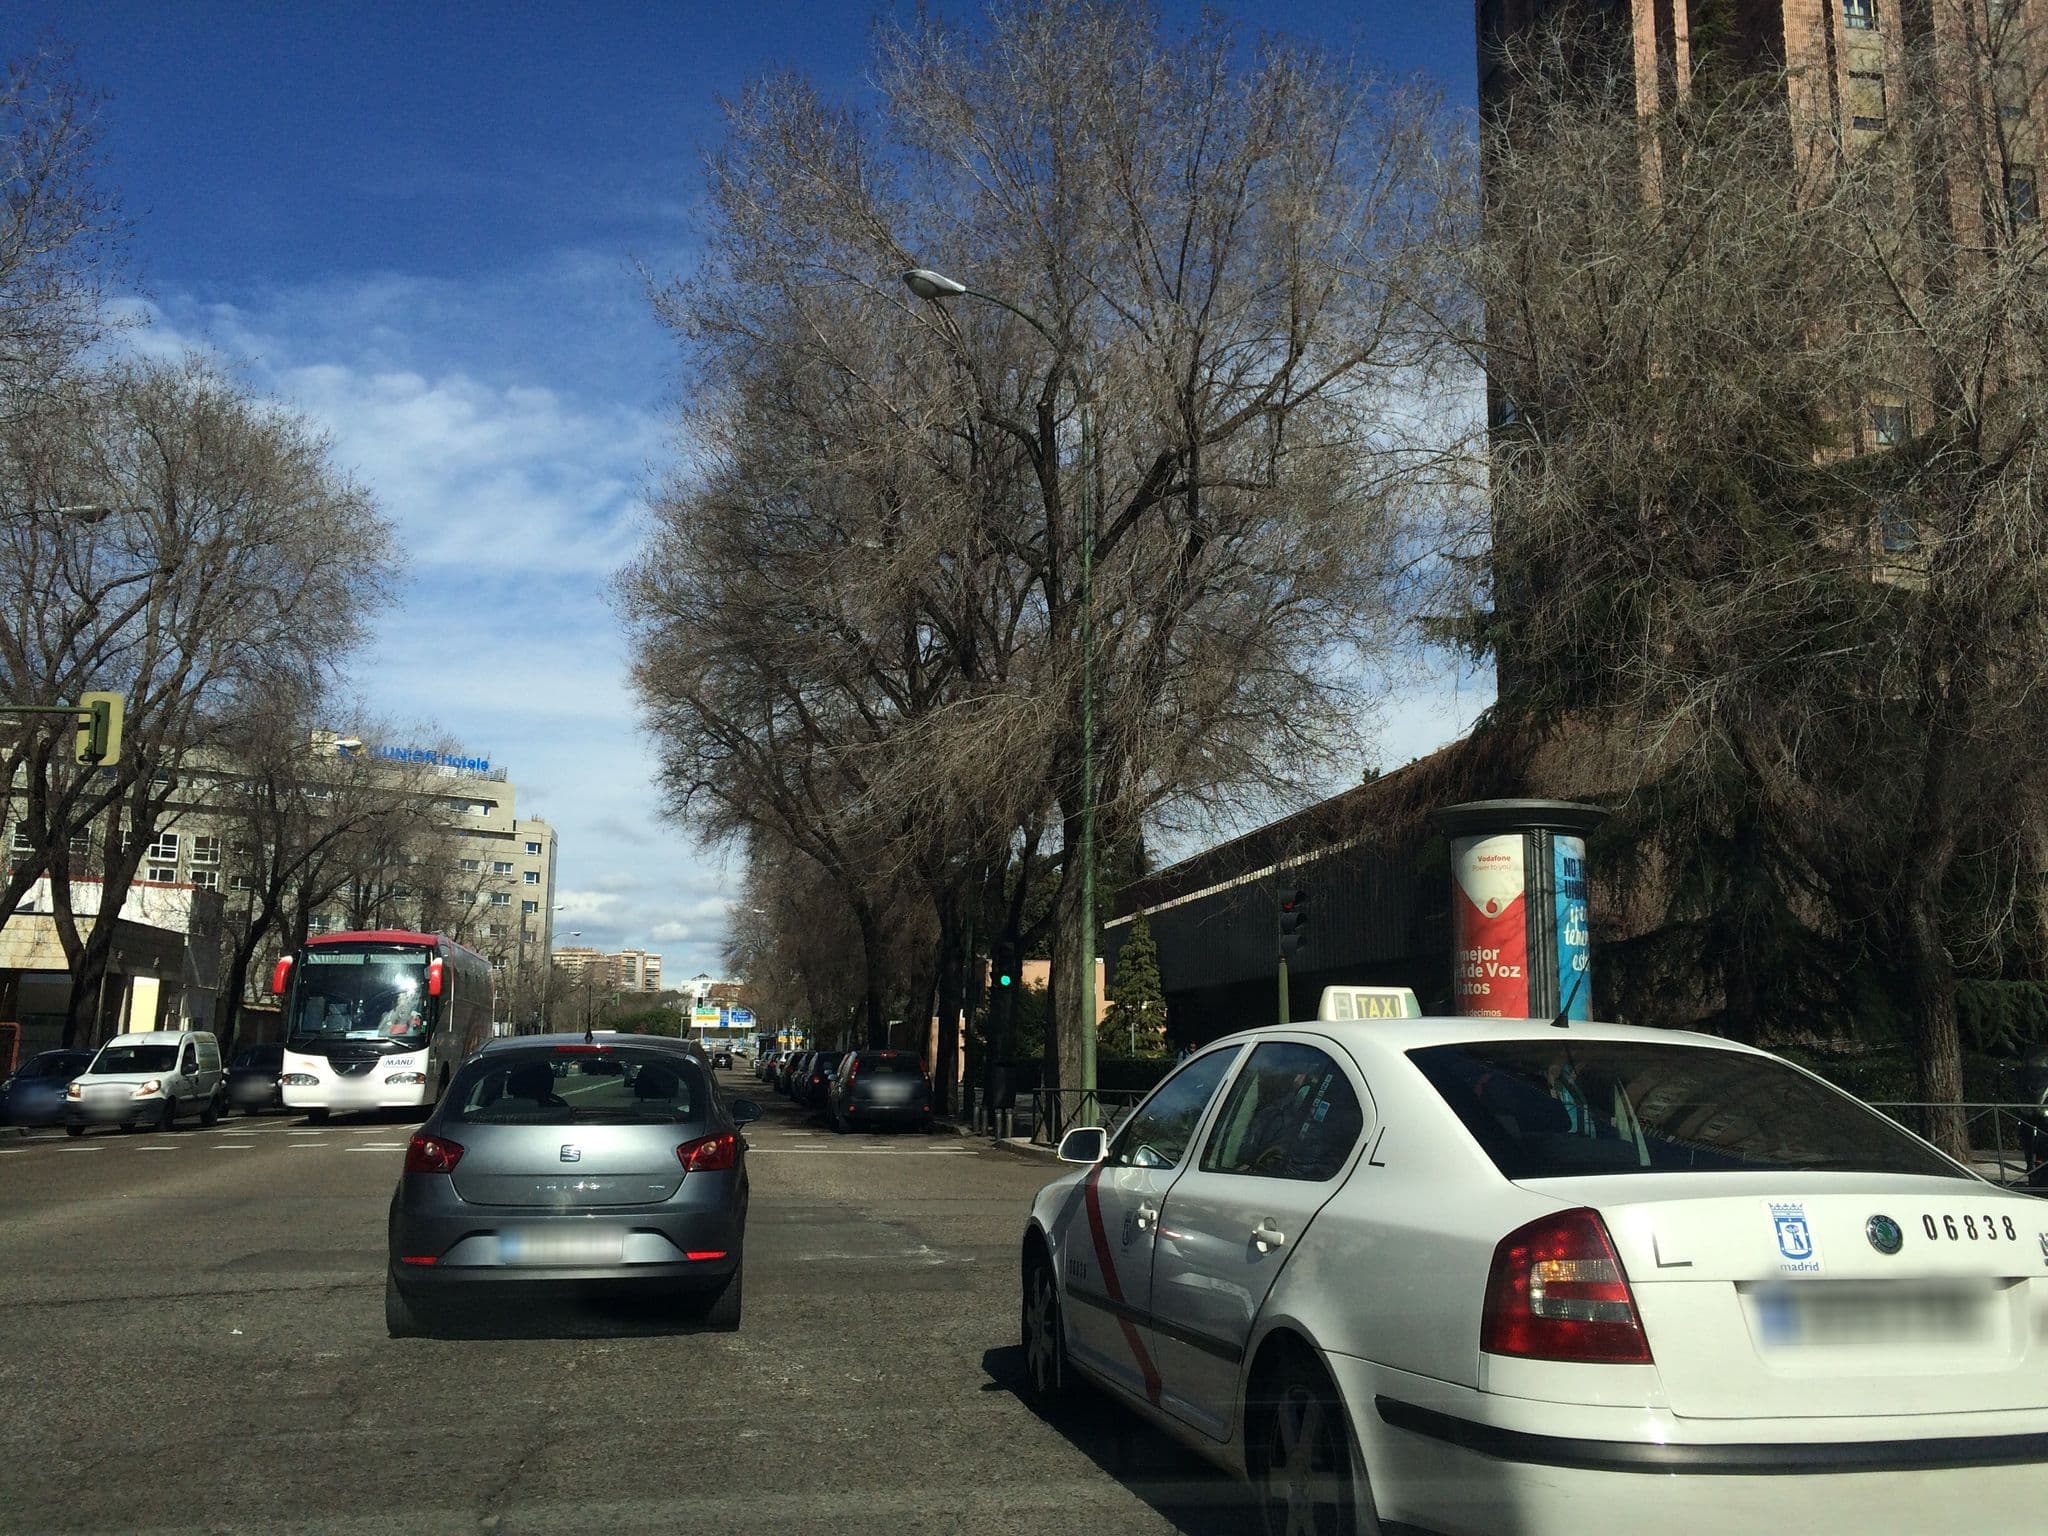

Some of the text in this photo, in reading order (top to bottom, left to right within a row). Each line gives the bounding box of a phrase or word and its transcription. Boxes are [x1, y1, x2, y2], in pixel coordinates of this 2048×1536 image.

[1563, 857, 1577, 878] NO
[1467, 963, 1484, 978] de
[1485, 962, 1522, 978] Voz
[1357, 997, 1401, 1018] TAXI
[1469, 1008, 1502, 1017] decimos
[1922, 1214, 2017, 1241] 06838
[1780, 1262, 1820, 1273] madrid
